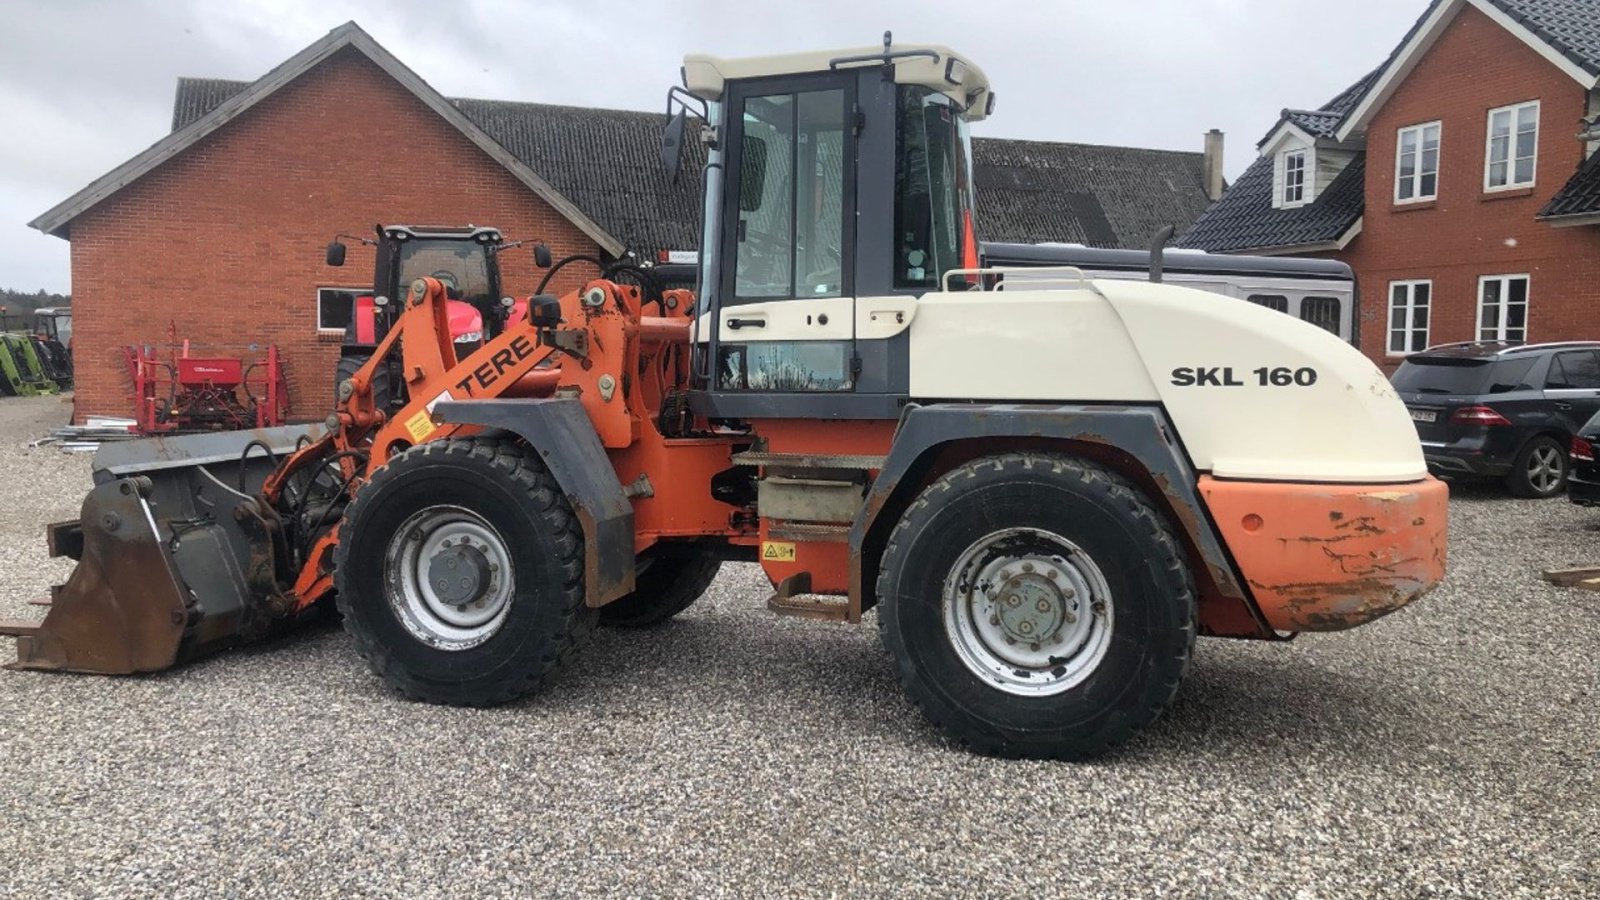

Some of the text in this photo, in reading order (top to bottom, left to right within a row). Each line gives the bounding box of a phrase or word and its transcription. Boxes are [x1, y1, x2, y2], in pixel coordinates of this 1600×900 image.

[455, 335, 541, 397] TERE
[1170, 367, 1317, 386] SKL 160
